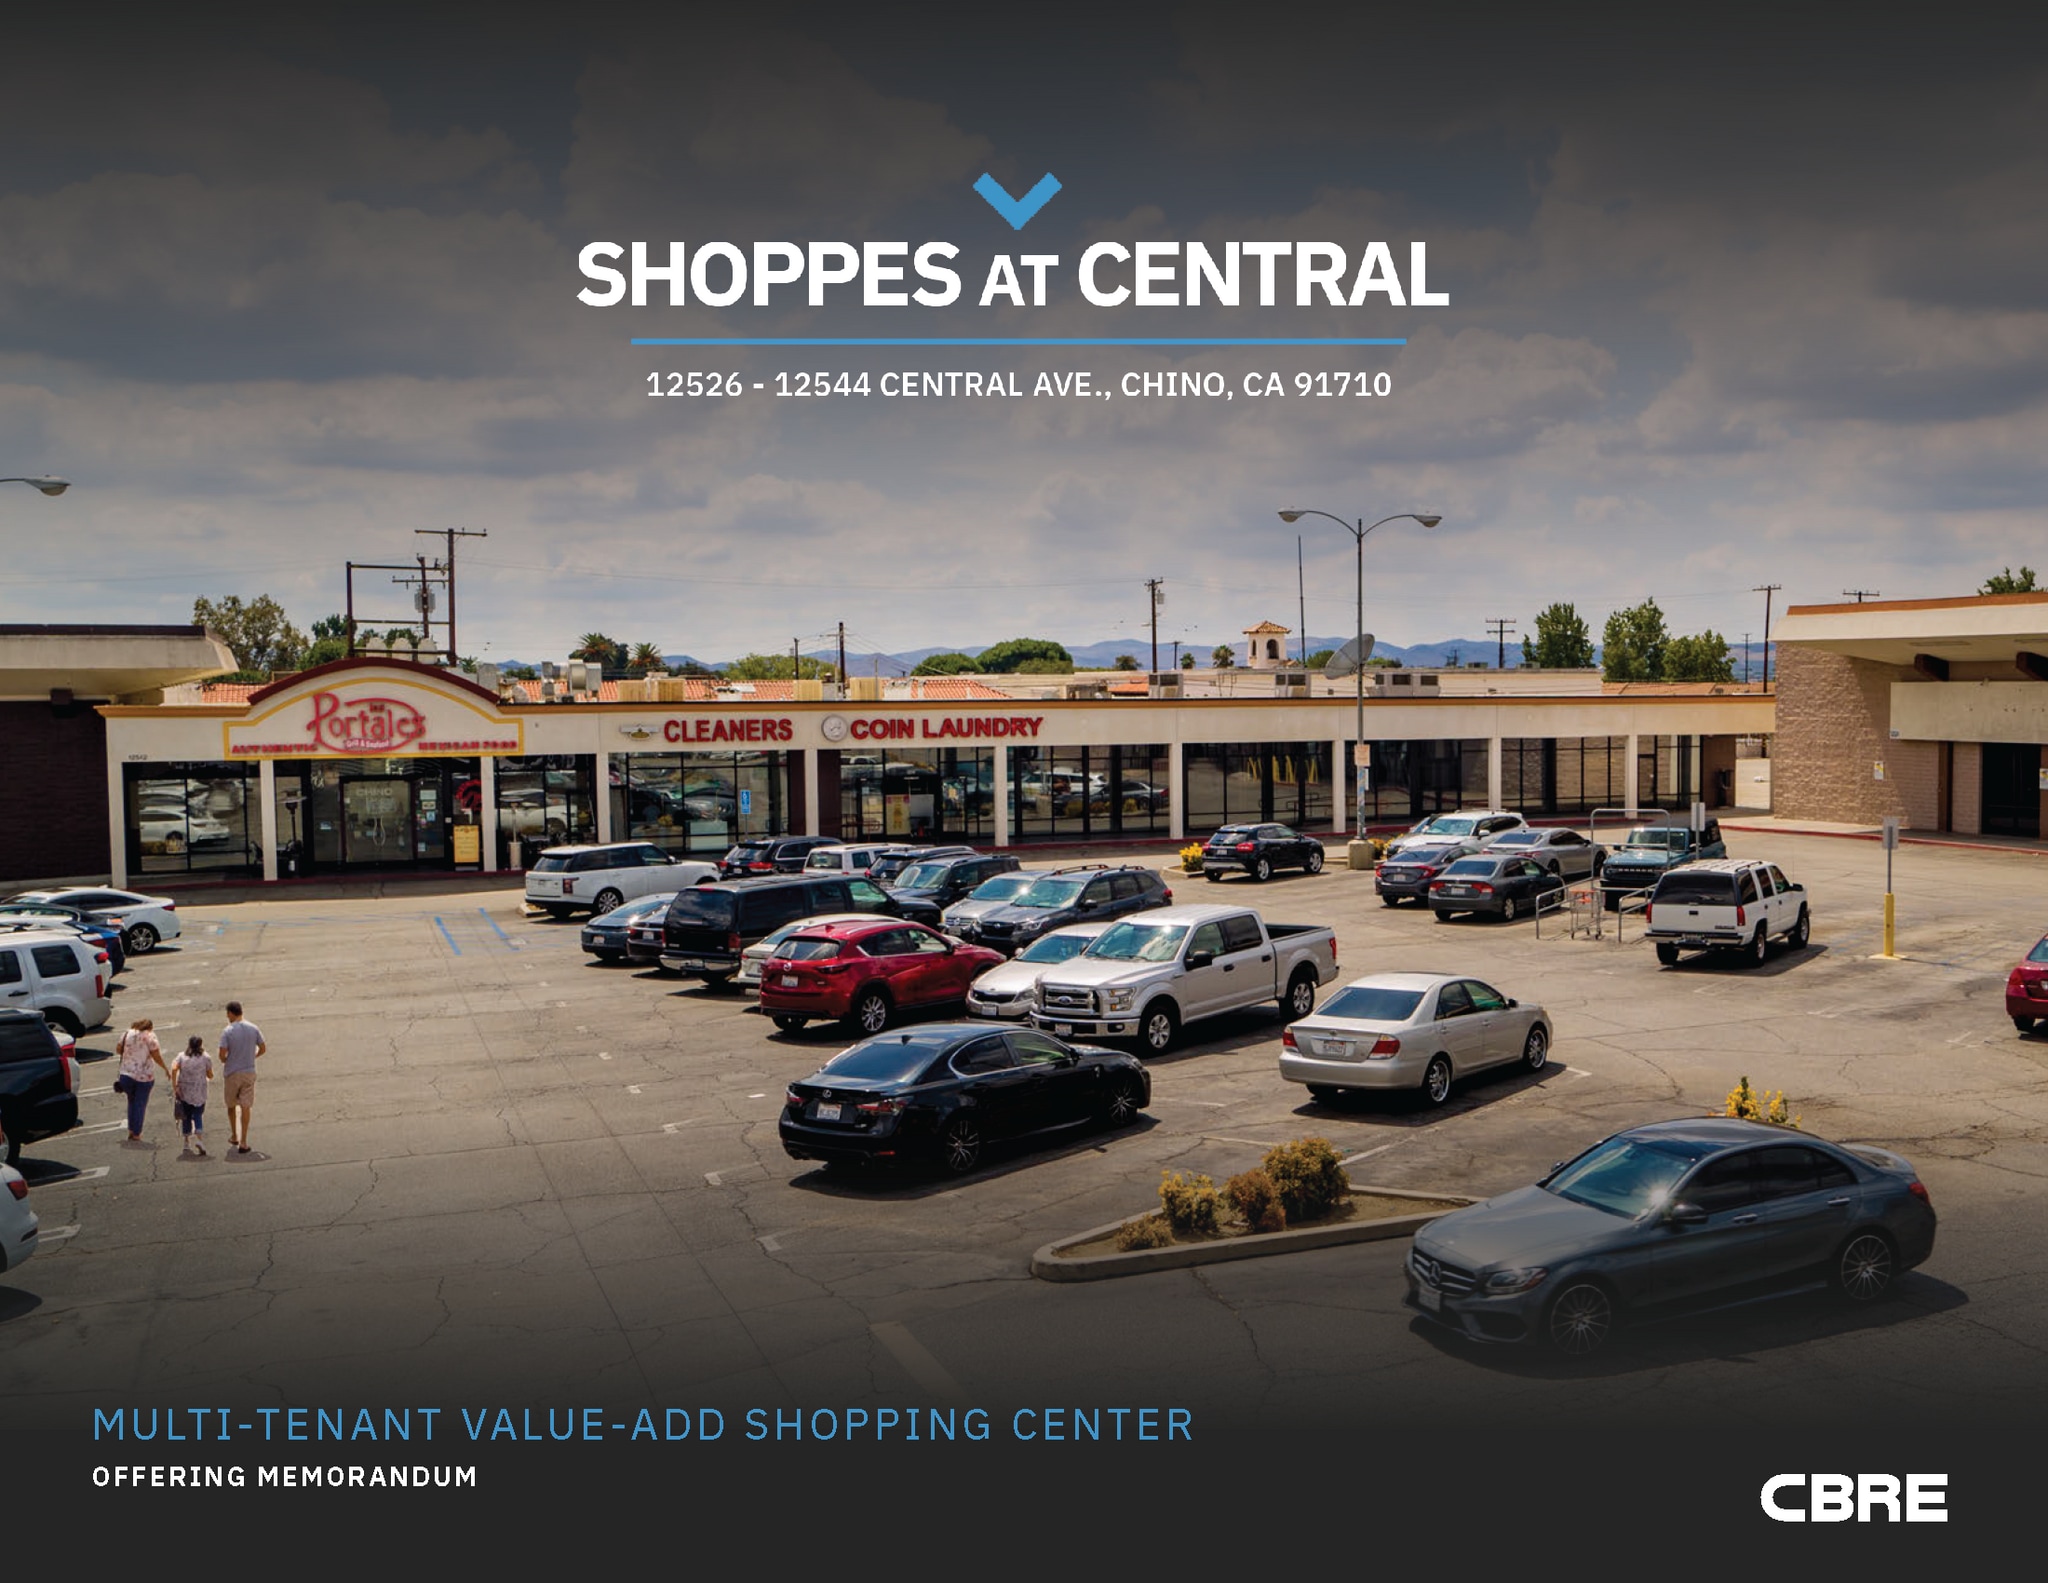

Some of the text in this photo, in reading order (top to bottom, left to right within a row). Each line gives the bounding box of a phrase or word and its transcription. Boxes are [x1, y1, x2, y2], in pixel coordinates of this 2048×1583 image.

[306, 692, 426, 743] Portales
[851, 716, 1043, 741] COIN LAUNDRY
[663, 718, 794, 743] CLEANERS
[232, 743, 318, 754] AUTHENTIC
